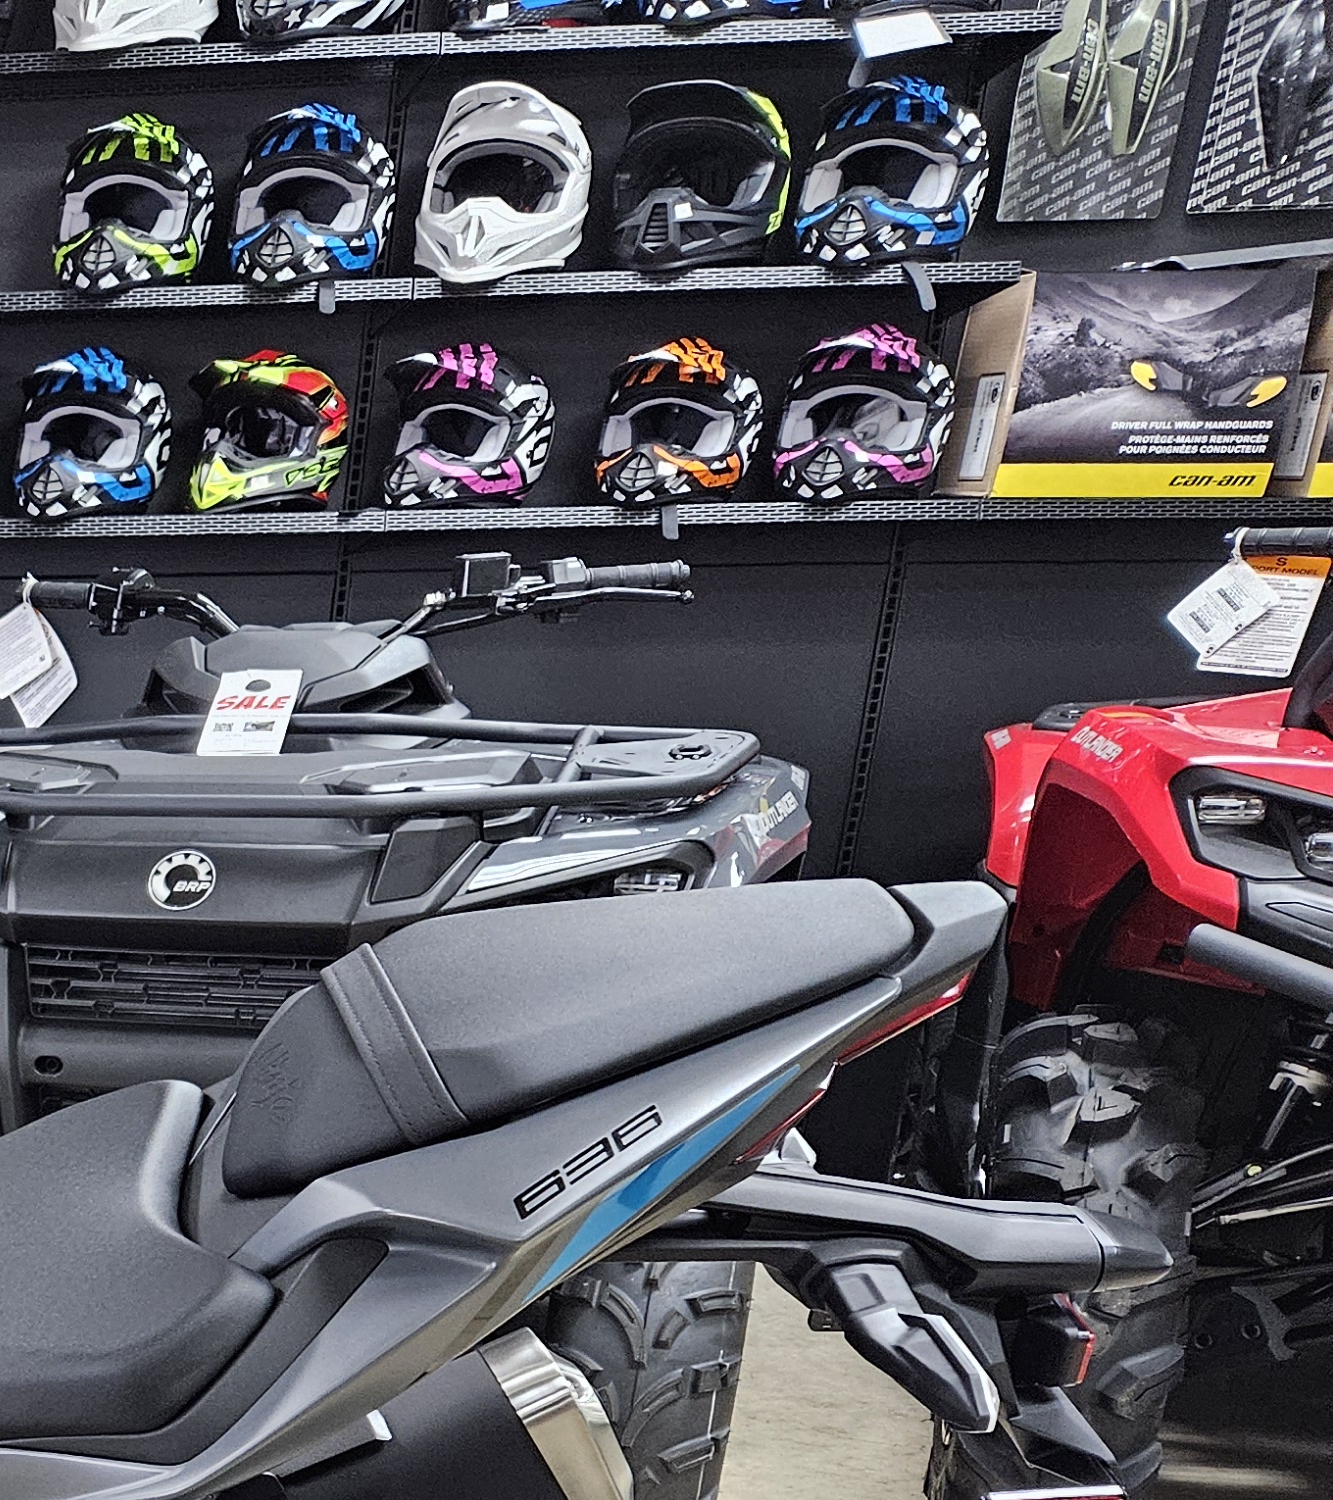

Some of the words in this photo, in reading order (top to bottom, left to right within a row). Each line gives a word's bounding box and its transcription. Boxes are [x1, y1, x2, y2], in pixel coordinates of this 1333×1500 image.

[1111, 421, 1148, 430] DRIVER
[1149, 421, 1172, 430] FULL
[1174, 421, 1204, 430] WRAP
[1205, 420, 1274, 430] HANDGUARDS
[1119, 445, 1148, 454] POUR
[1199, 444, 1267, 454] CONDUCTEUR
[1168, 475, 1256, 487] can-am
[1281, 566, 1319, 576] MODEL
[215, 694, 291, 711] SALE
[172, 880, 211, 893] BRP
[512, 1104, 663, 1221] 636
